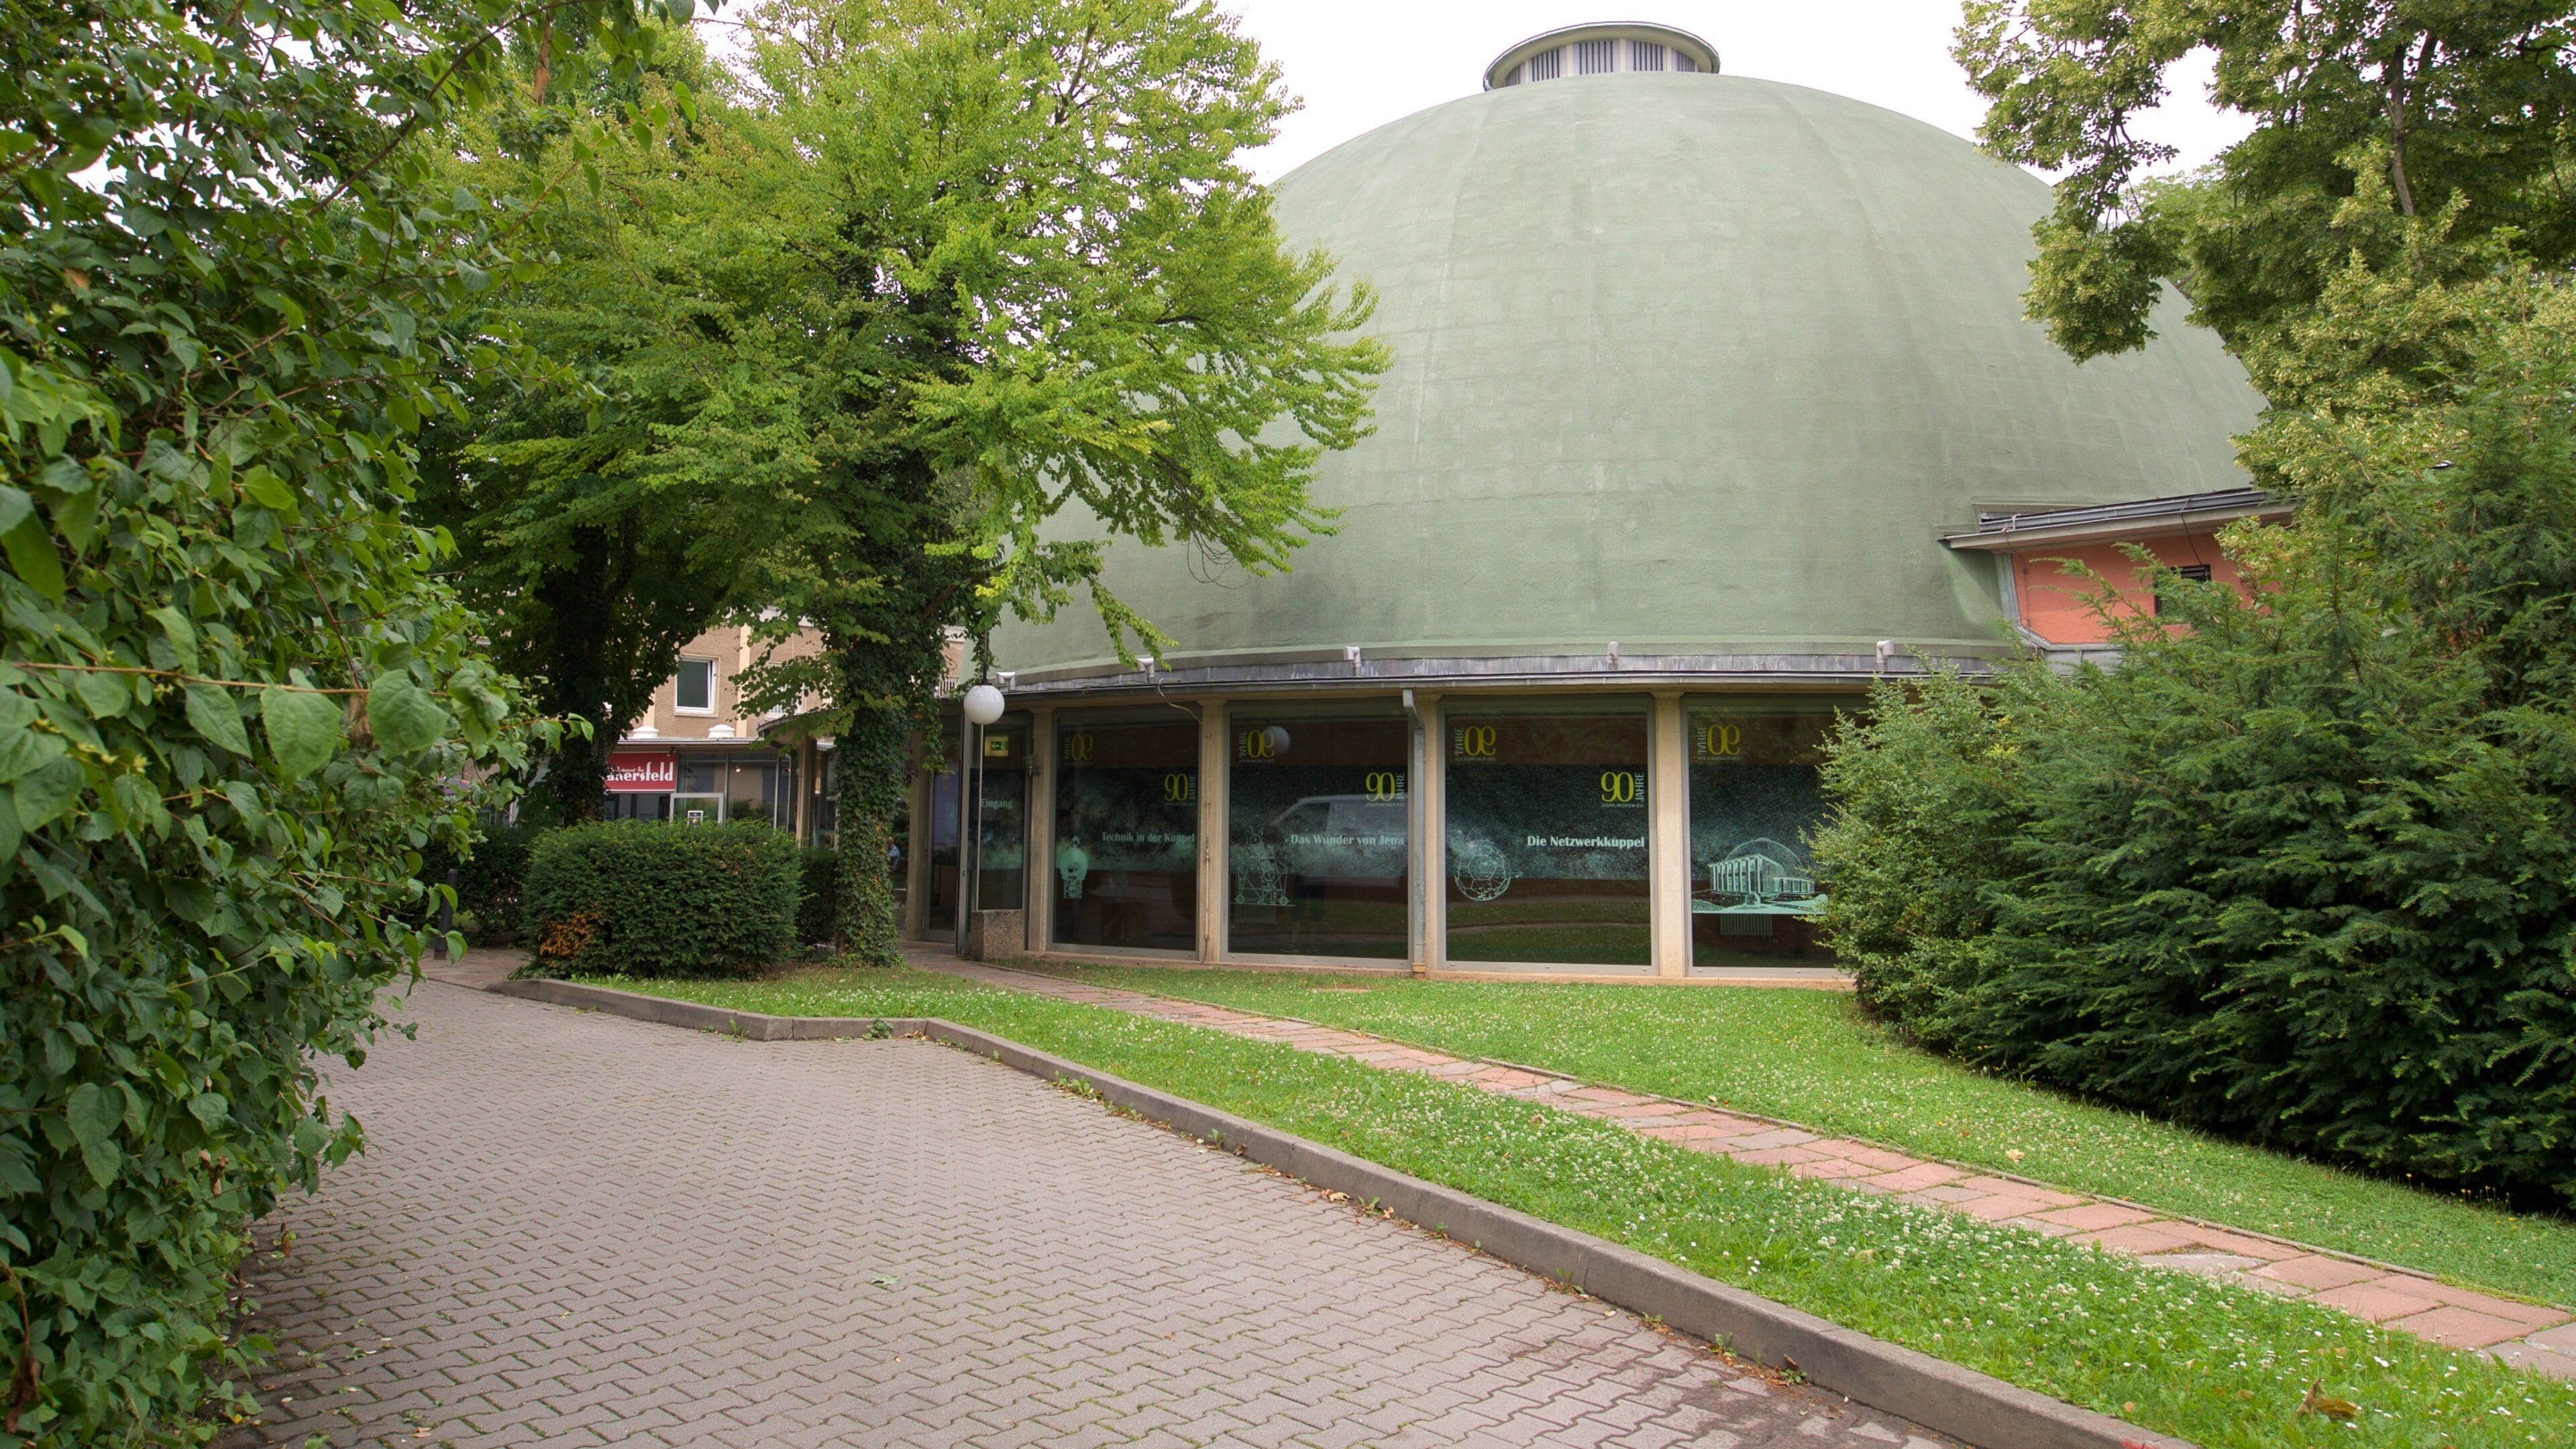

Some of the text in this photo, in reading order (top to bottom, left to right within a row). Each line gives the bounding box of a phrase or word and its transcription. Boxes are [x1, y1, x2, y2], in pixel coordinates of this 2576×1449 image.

[606, 762, 674, 782] auersfeld
[1164, 773, 1188, 801] 90
[1366, 772, 1395, 802] 90
[1396, 773, 1404, 802] JAHRE
[1601, 772, 1634, 802] 90
[1635, 773, 1644, 802] JAHRE
[981, 798, 1013, 810] Eingang
[1102, 832, 1195, 844] Technik in der Kuppel
[1291, 835, 1404, 845] Das Wunder von Jena
[1527, 835, 1645, 849] Die Netzwerkkuppel
